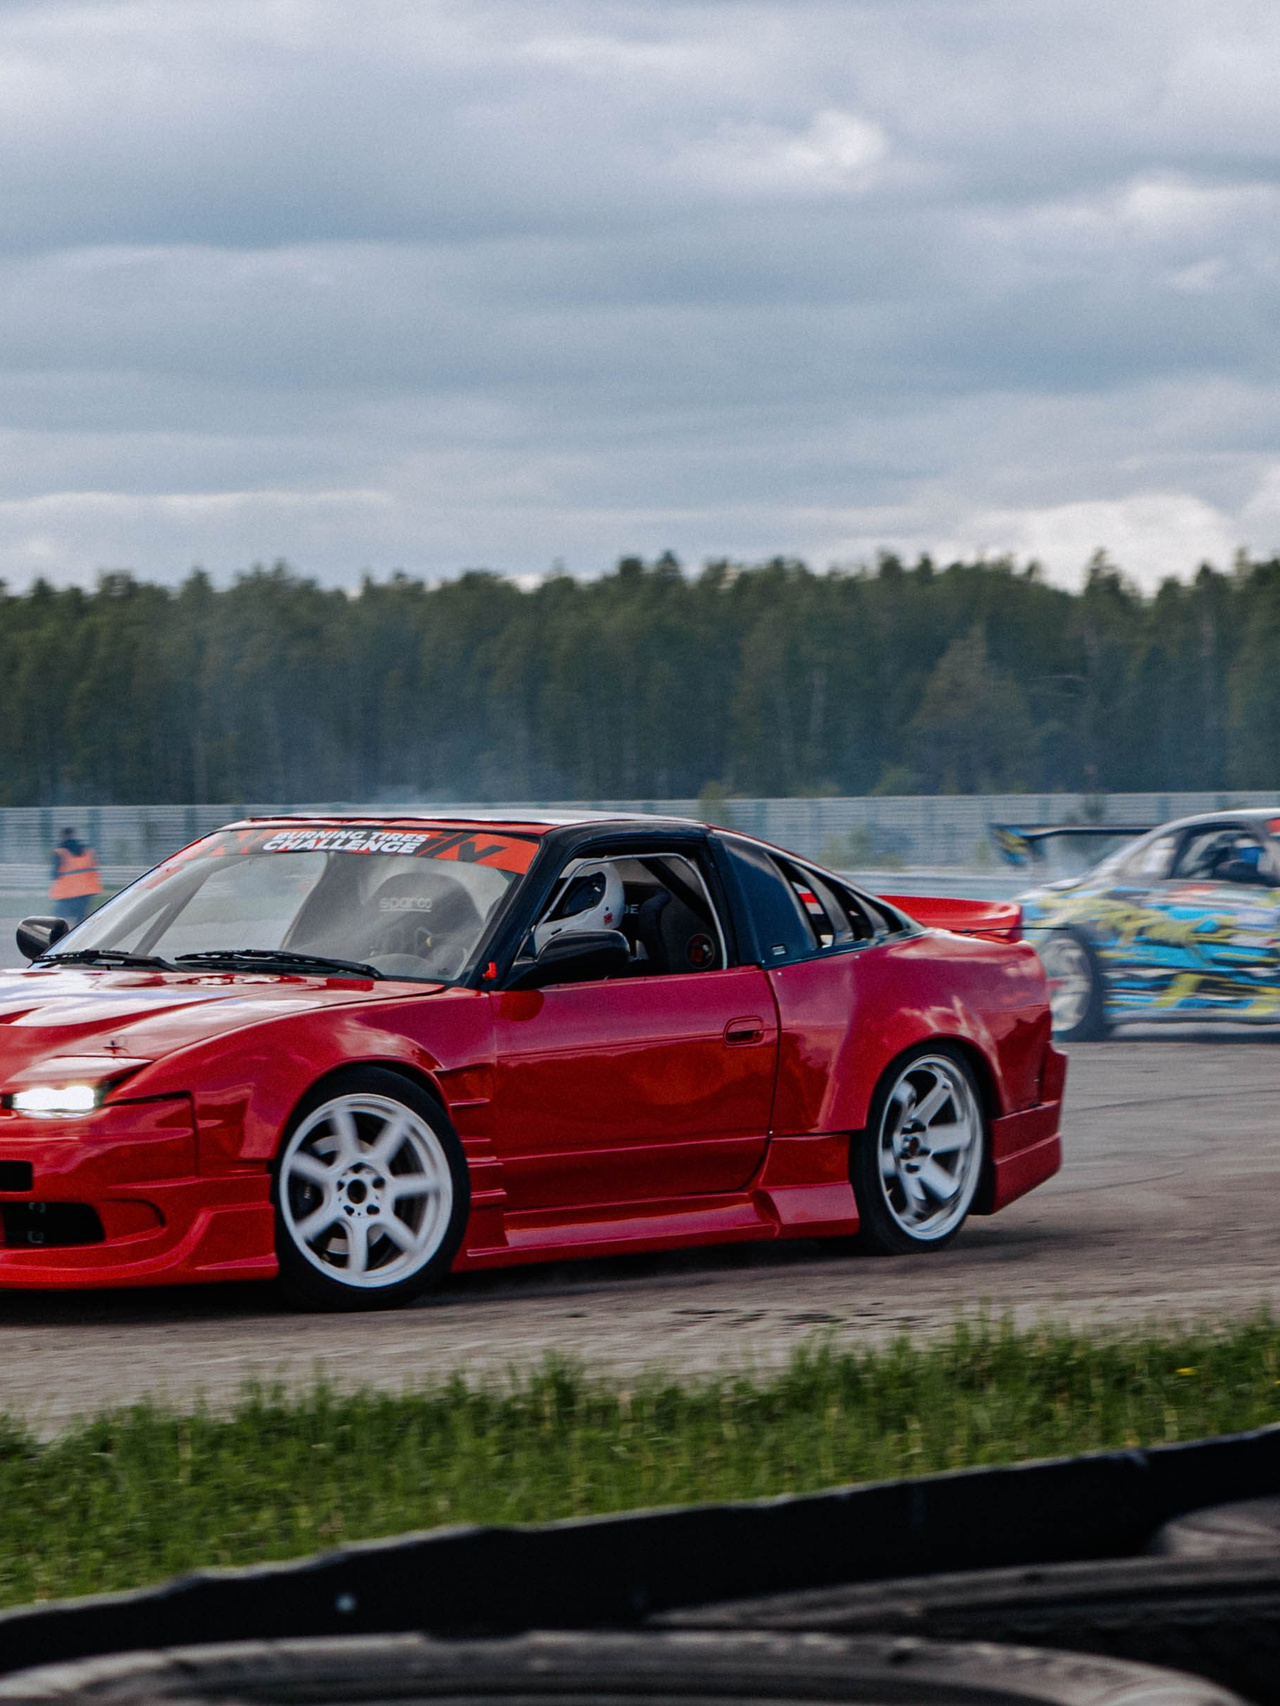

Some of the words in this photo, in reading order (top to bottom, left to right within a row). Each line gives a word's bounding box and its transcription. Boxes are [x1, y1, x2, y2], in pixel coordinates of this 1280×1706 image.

[272, 830, 366, 841] BURNING
[370, 831, 430, 843] TIRES
[262, 838, 422, 854] CHALLENGE
[379, 896, 433, 909] sparco
